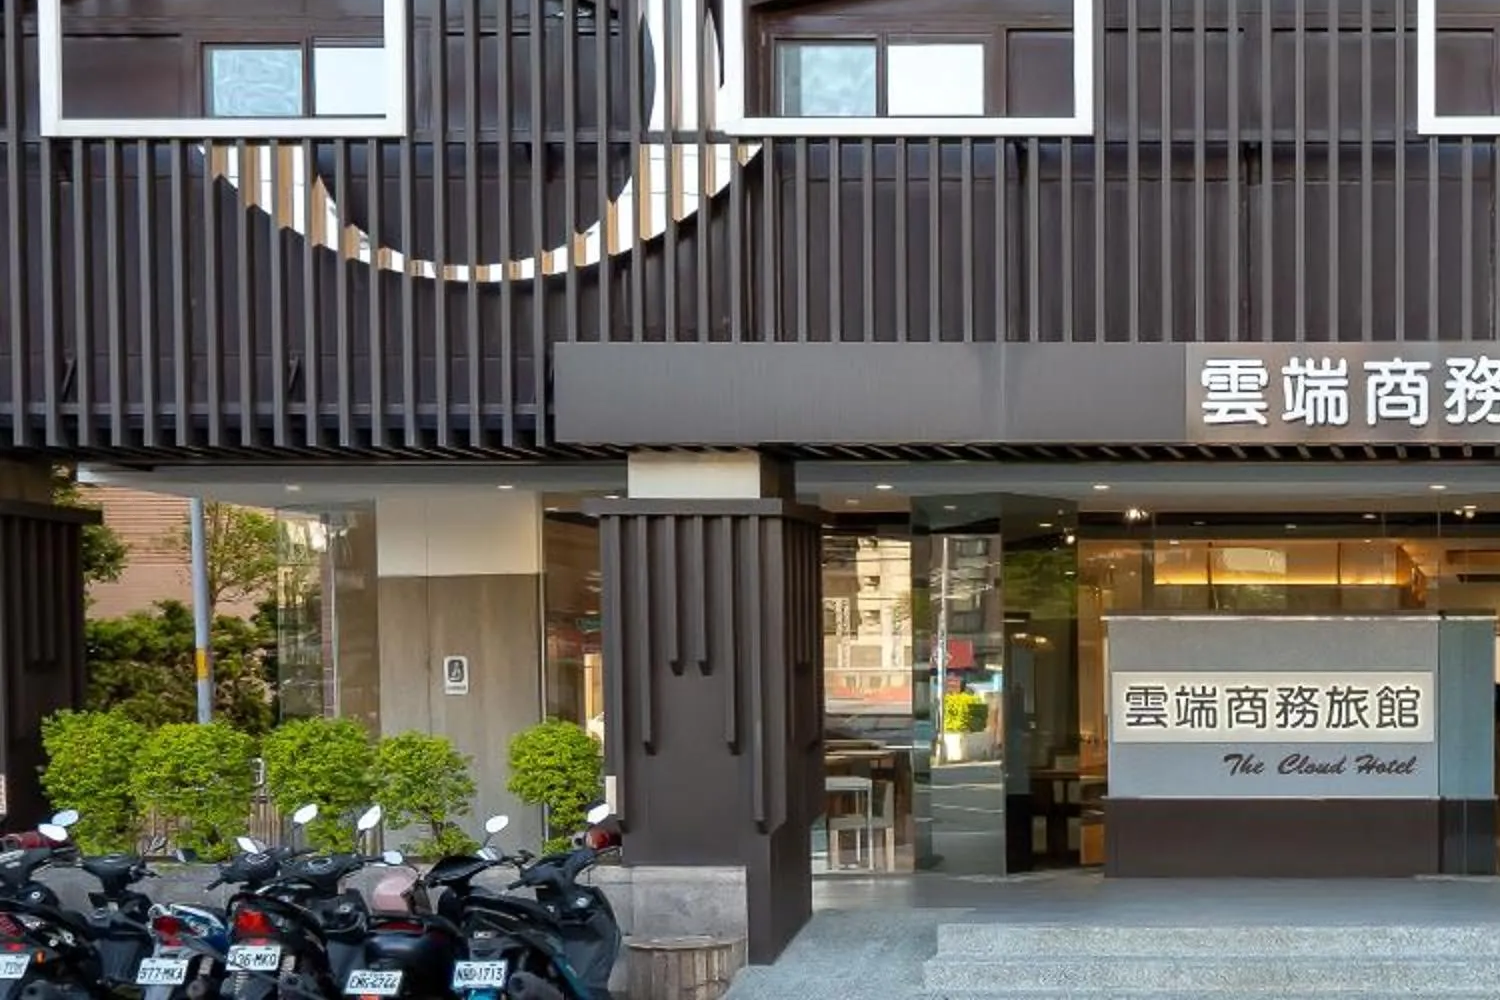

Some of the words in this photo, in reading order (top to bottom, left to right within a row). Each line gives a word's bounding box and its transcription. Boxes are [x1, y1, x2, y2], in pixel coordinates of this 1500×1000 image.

[1125, 685, 1421, 729] 雲端商務旅館
[1223, 753, 1264, 775] The
[1277, 753, 1347, 775] Cloud
[1355, 753, 1417, 775] Hotel
